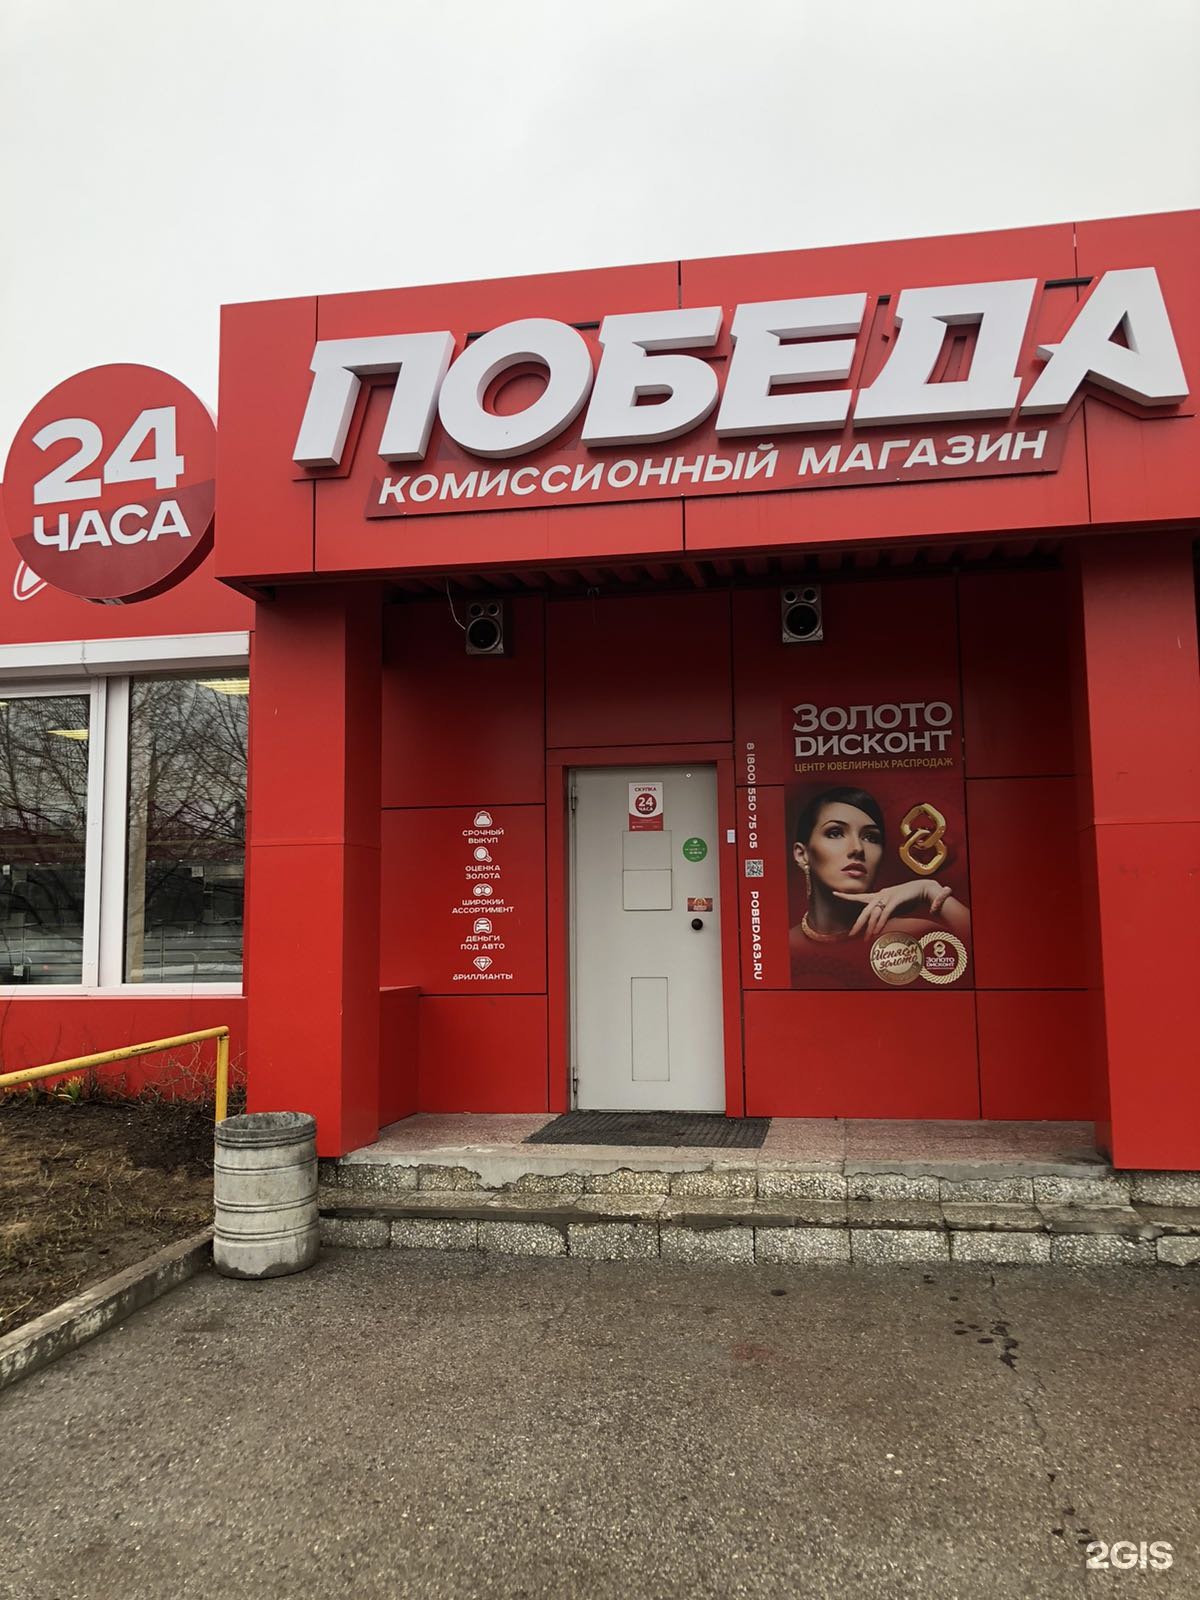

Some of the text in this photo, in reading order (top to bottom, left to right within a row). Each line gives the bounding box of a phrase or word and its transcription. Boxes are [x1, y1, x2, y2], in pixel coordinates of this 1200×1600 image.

[293, 267, 1189, 467] ПОБЕДА
[32, 406, 184, 505] 24
[378, 430, 1048, 504] КОМИССИОННЫЙ МАГАЗИН
[33, 500, 191, 551] ЧАСА
[794, 757, 953, 773] ЦЕНТР ЮВЕЛИРНЫХ РАСПРОДАЖ
[638, 797, 654, 807] 24
[748, 787, 757, 811] 550
[749, 814, 758, 829] 75
[462, 828, 505, 837] СРОЧНЫЙ
[749, 832, 758, 849] 05
[452, 906, 515, 914] АССОРТИМЕНТ
[465, 935, 501, 943] ДЕНЬГИ
[750, 891, 763, 980] POBEDA63.RU
